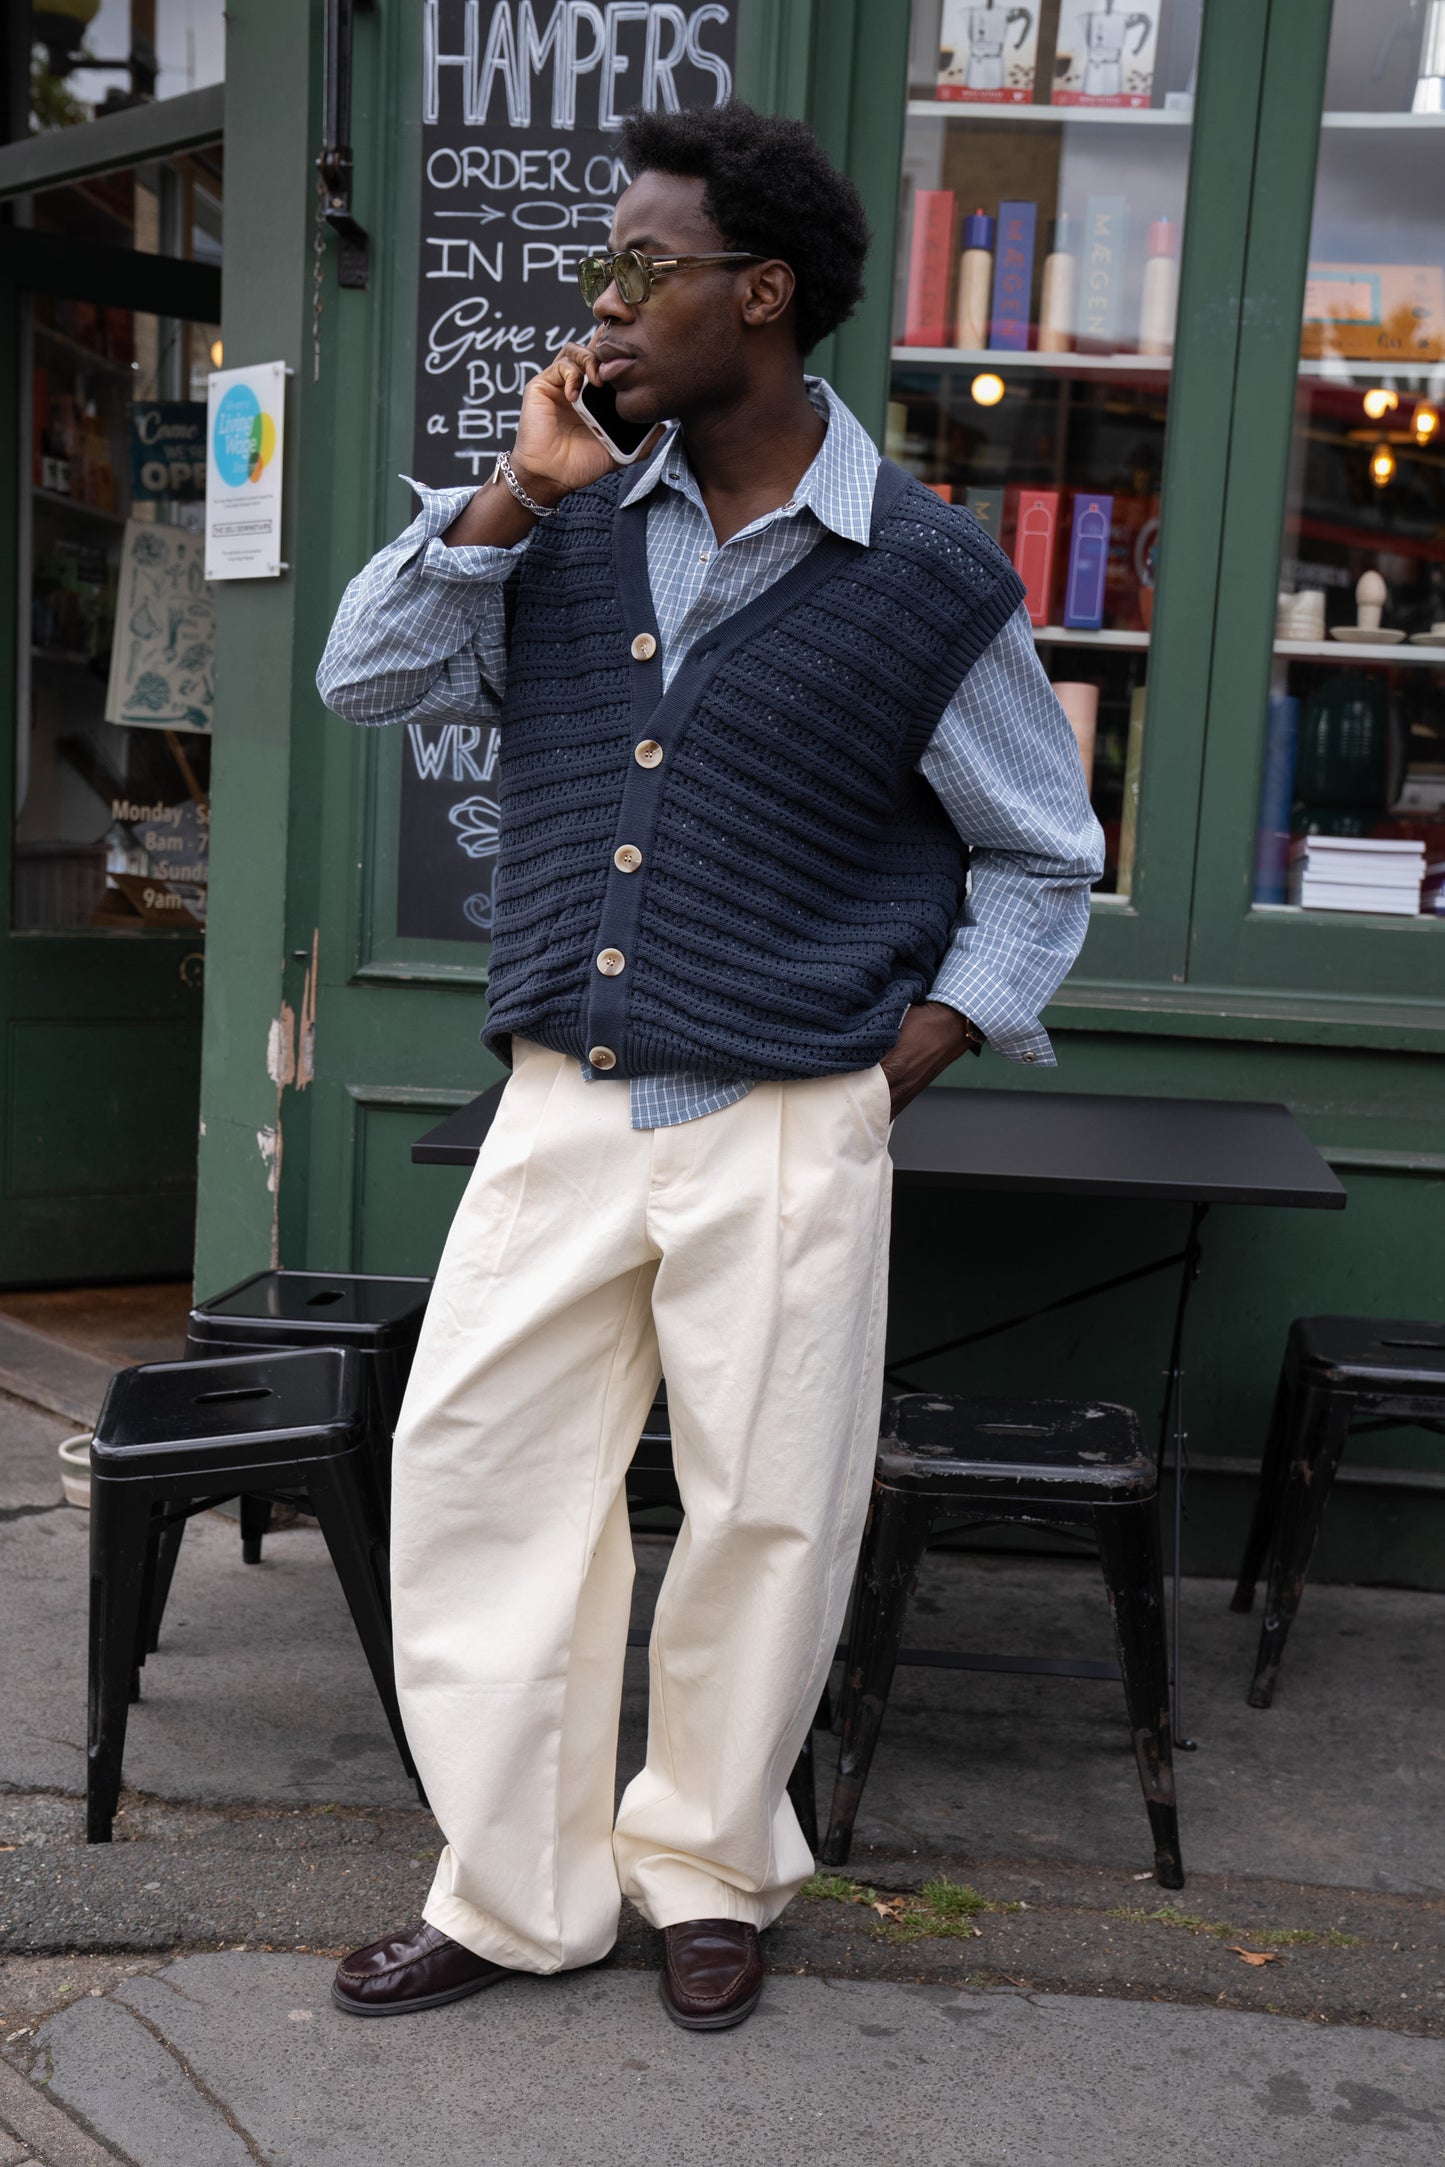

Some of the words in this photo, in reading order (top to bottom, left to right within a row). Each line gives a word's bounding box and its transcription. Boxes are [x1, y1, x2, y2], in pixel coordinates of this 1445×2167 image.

[423, 0, 733, 131] HAMPERS
[427, 146, 581, 193] ORDER
[426, 237, 503, 282] IN
[425, 296, 536, 374] Give
[135, 410, 199, 445] Come
[218, 412, 255, 436] Living
[427, 414, 450, 434] a
[225, 434, 257, 460] Wage
[112, 799, 182, 828] Monday
[144, 831, 183, 851] 8am
[143, 888, 182, 909] 9am
